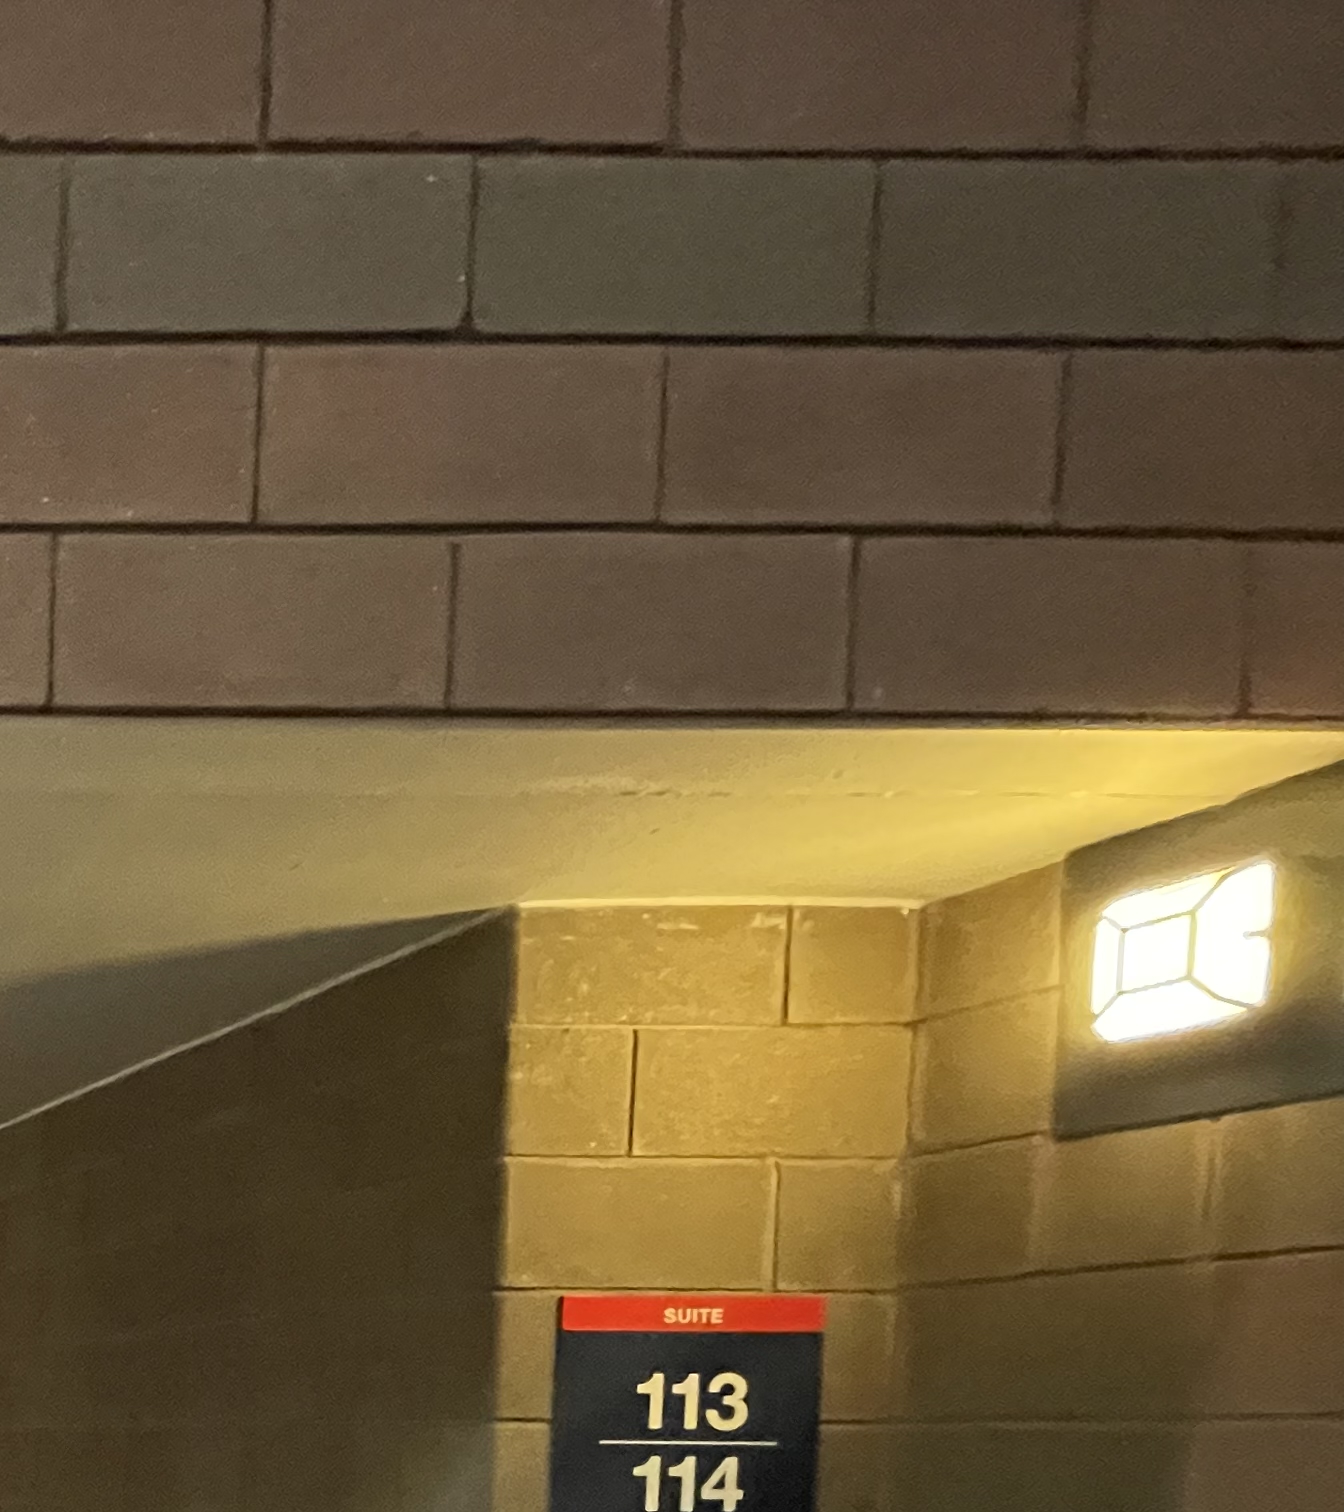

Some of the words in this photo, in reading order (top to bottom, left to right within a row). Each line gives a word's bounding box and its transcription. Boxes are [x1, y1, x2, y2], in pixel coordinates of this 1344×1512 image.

[663, 1307, 724, 1324] SUITE
[636, 1372, 749, 1432] 113
[632, 1455, 744, 1512] 114
